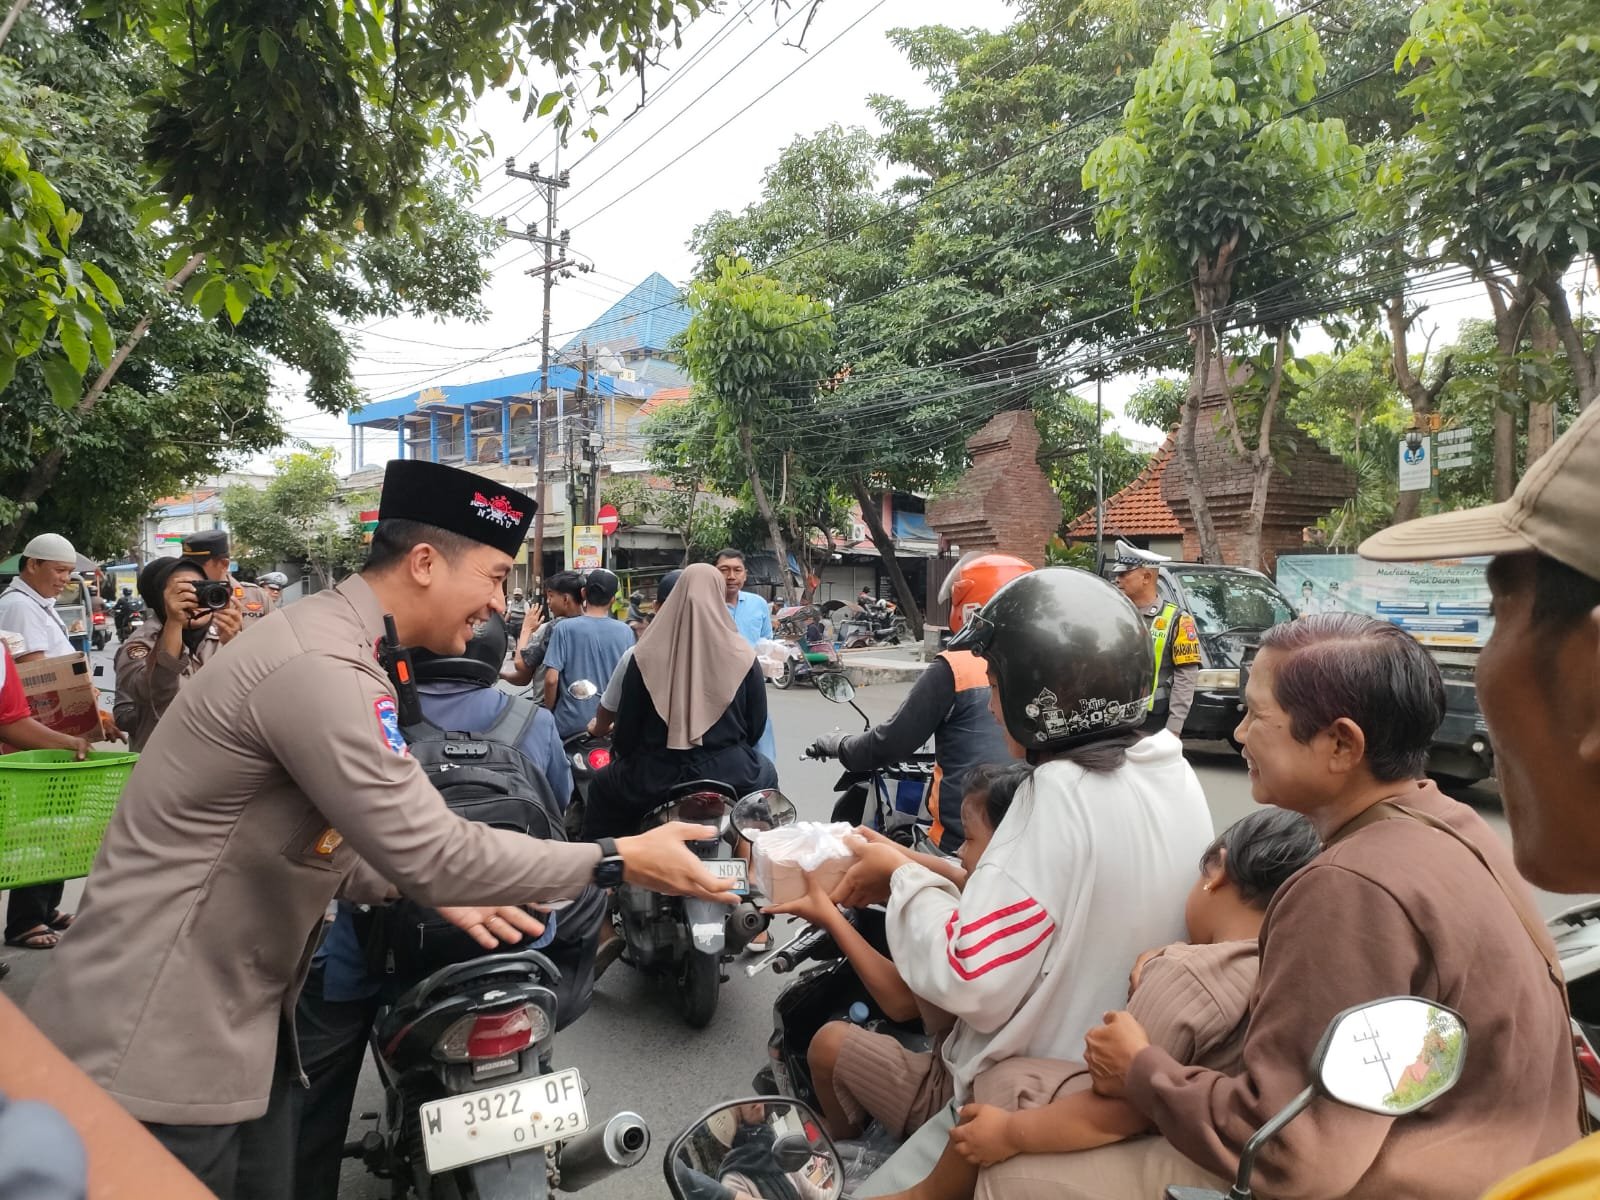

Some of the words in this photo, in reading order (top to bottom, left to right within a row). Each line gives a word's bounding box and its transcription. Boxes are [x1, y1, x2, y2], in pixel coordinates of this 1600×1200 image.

[475, 1058, 516, 1073] HONDA
[425, 1107, 443, 1135] W
[462, 1089, 524, 1126] 3922
